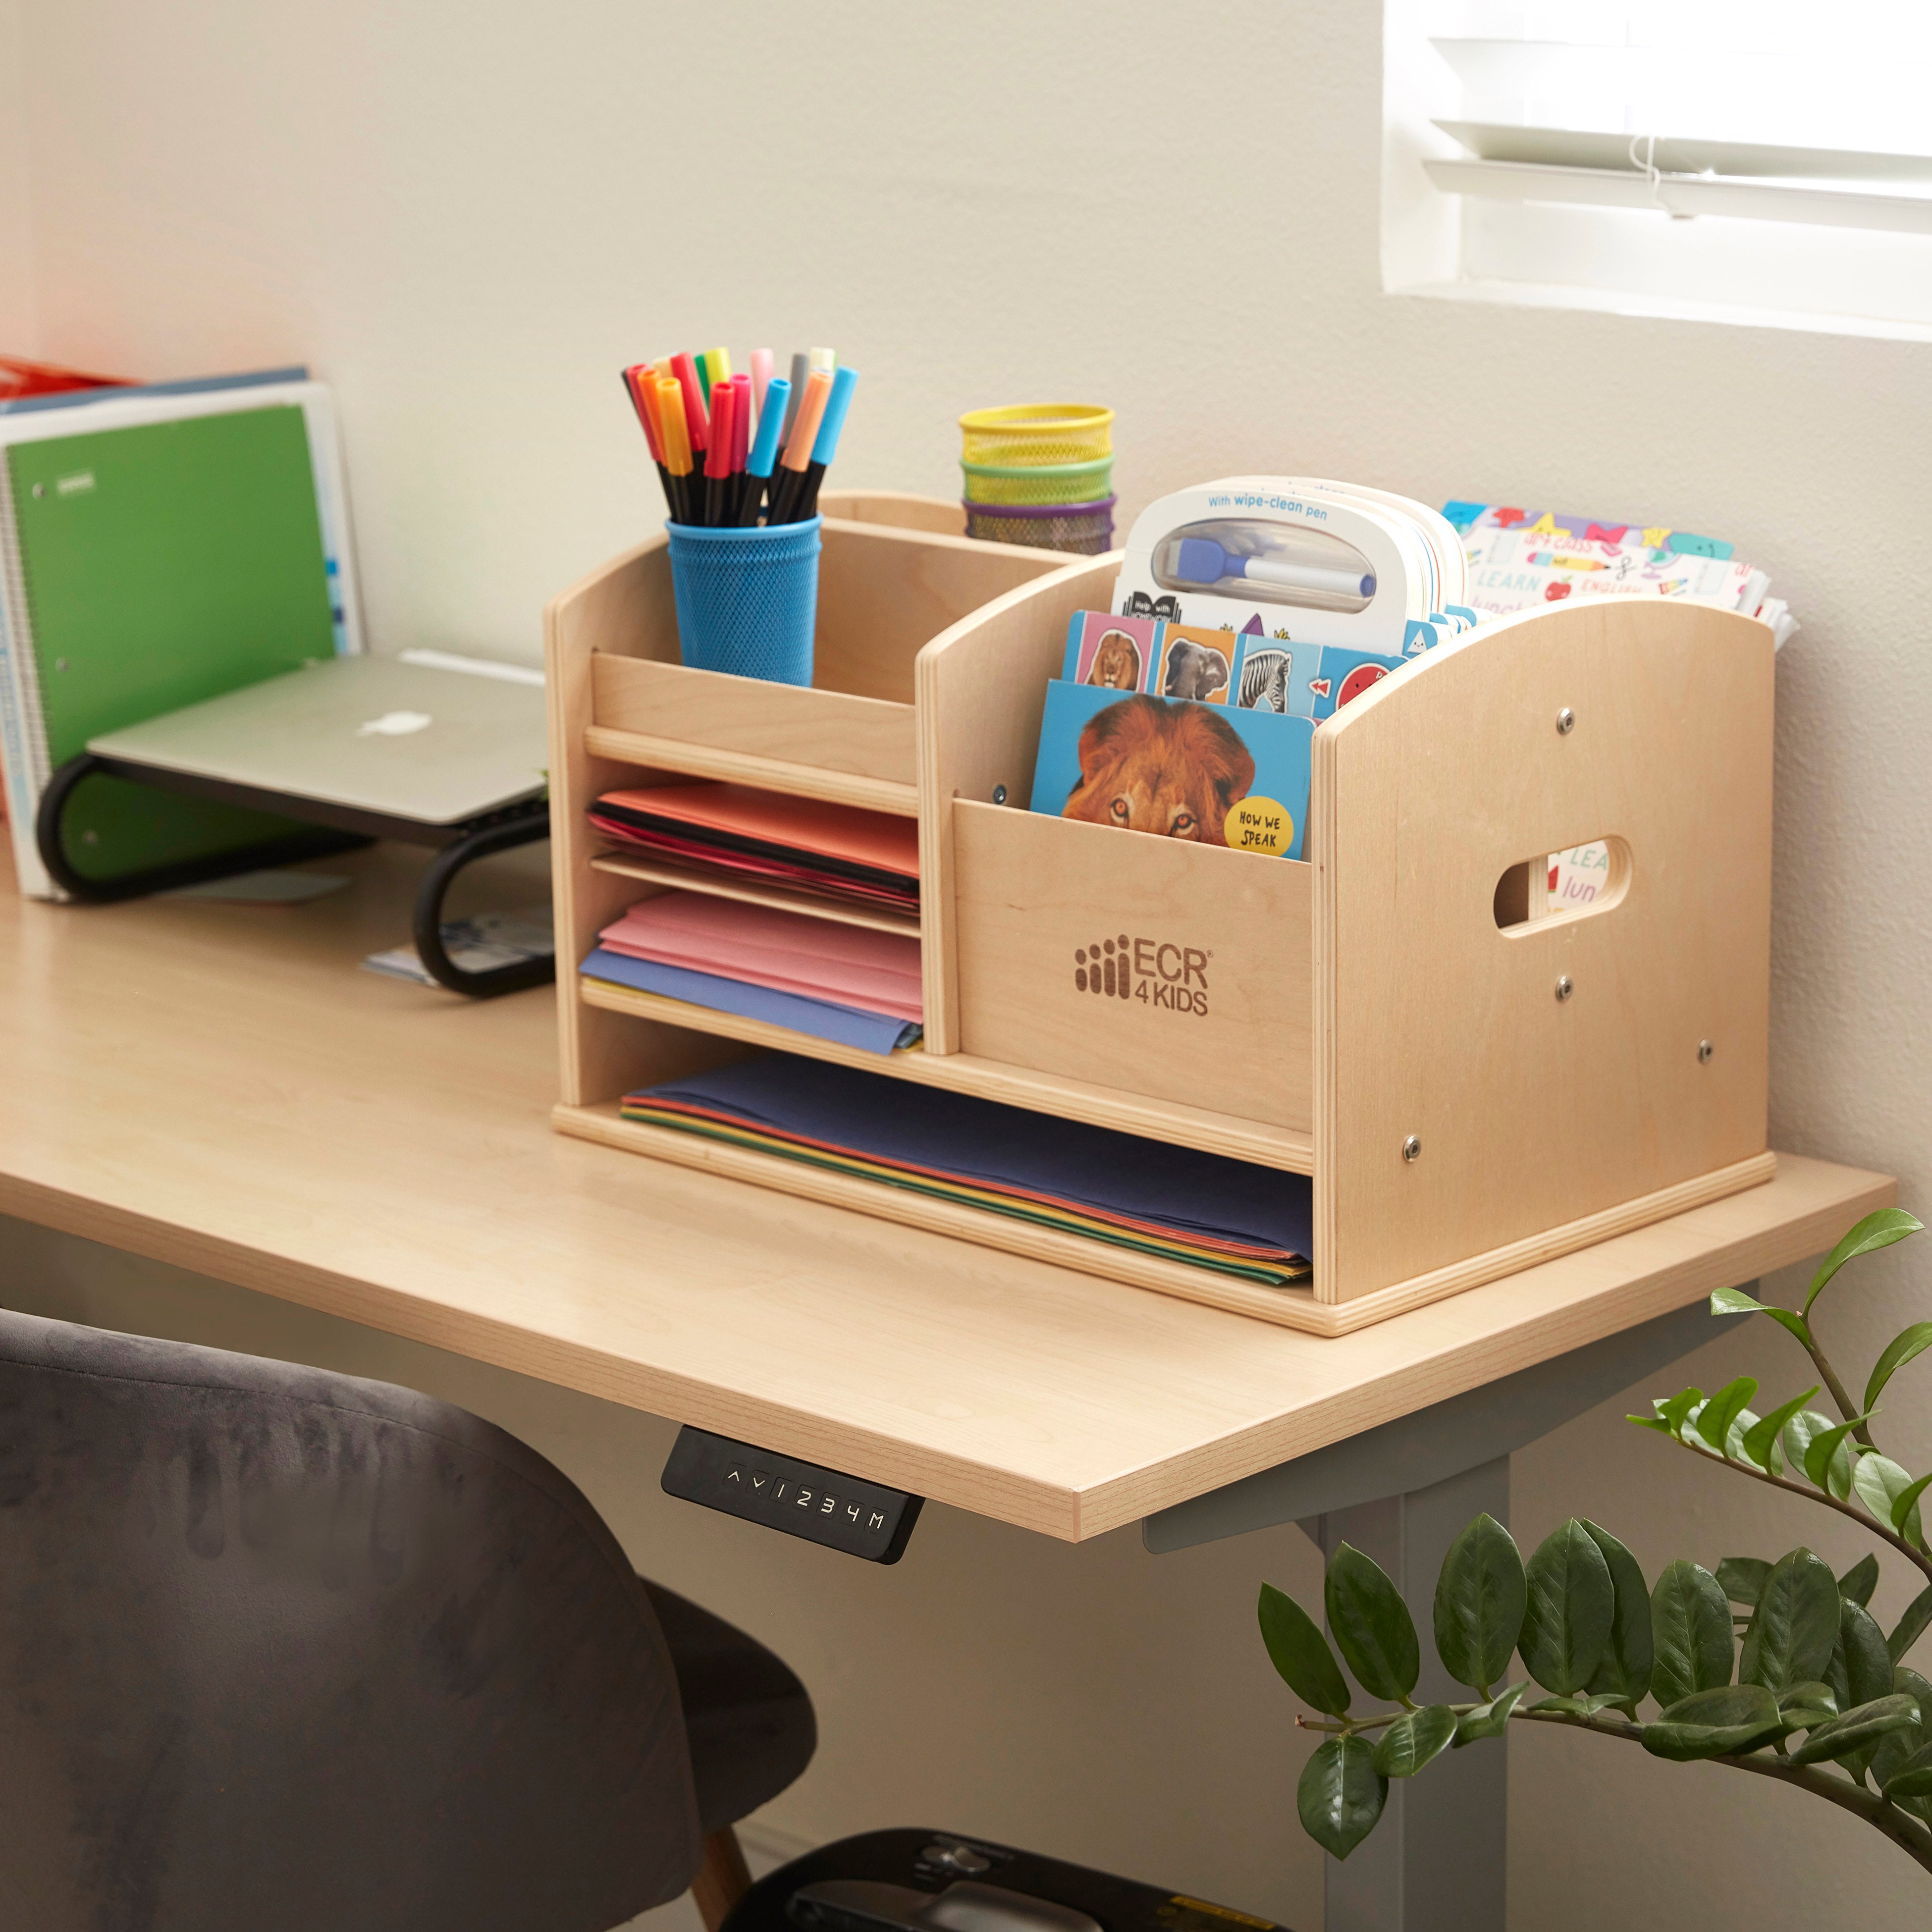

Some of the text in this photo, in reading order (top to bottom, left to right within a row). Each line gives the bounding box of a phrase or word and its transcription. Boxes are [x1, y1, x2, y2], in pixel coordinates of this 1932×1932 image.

[1208, 493, 1328, 520] With wipe-clean pen
[1553, 537, 1593, 553] class
[1476, 569, 1540, 591] LEARN
[1134, 599, 1171, 614] Help with
[1239, 811, 1280, 830] HOW WE
[1240, 829, 1277, 847] SPEAK
[1134, 979, 1208, 1017] 4 KIDS
[777, 1484, 884, 1529] 1 2 3 4 M
